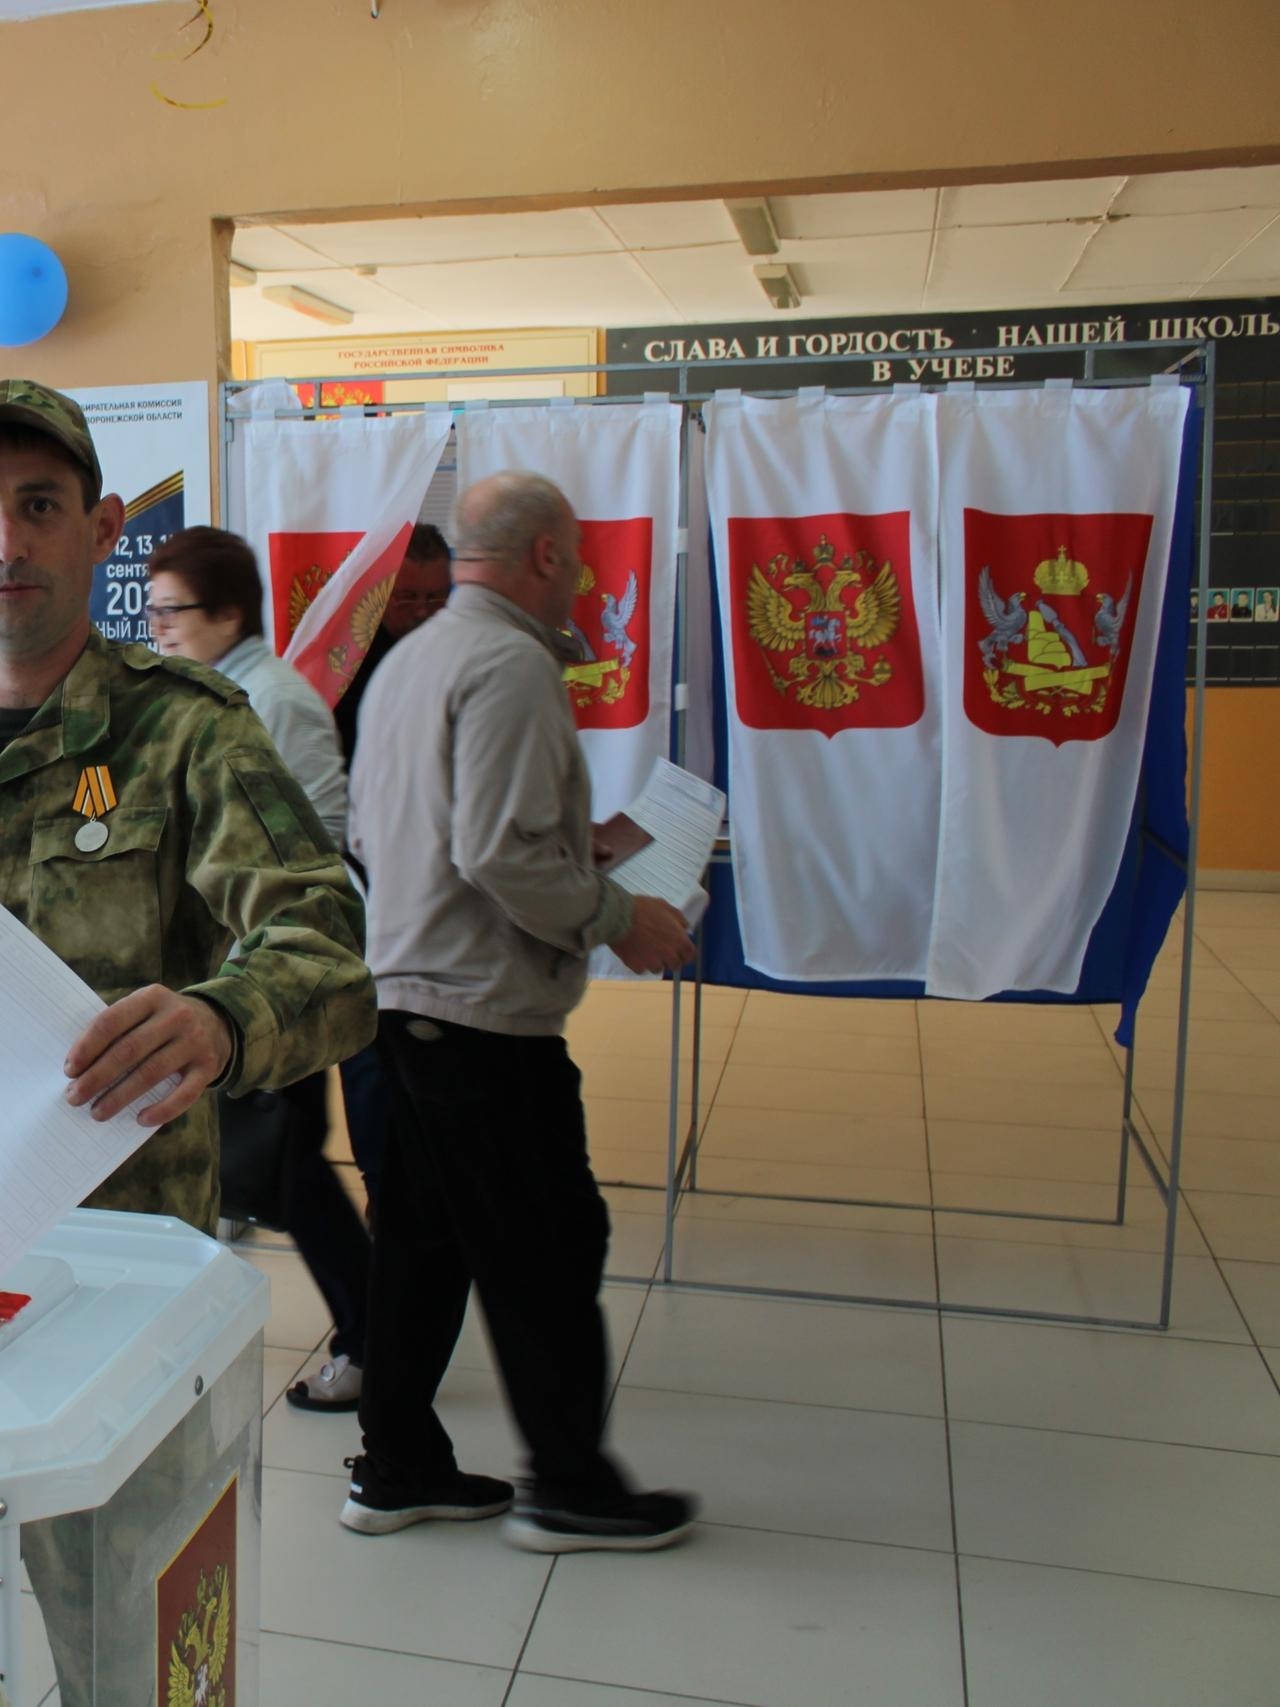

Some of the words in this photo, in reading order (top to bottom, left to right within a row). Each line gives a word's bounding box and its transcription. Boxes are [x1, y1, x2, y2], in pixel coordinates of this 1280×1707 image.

[644, 338, 745, 363] СЛАВА
[756, 336, 780, 358] И
[788, 328, 954, 357] ГОРДОСТЬ
[997, 315, 1127, 347] НАШЕЙ
[440, 344, 505, 354] СИМВОЛИКА
[354, 358, 422, 369] РОССИЙСКОЙ
[426, 355, 489, 366] ФЕДЕРАЦИИ
[872, 360, 892, 382] В
[909, 355, 1015, 381] УЧЕБЕ
[137, 399, 182, 410] КОМИССИЯ
[146, 411, 183, 422] ОБЛАСТИ
